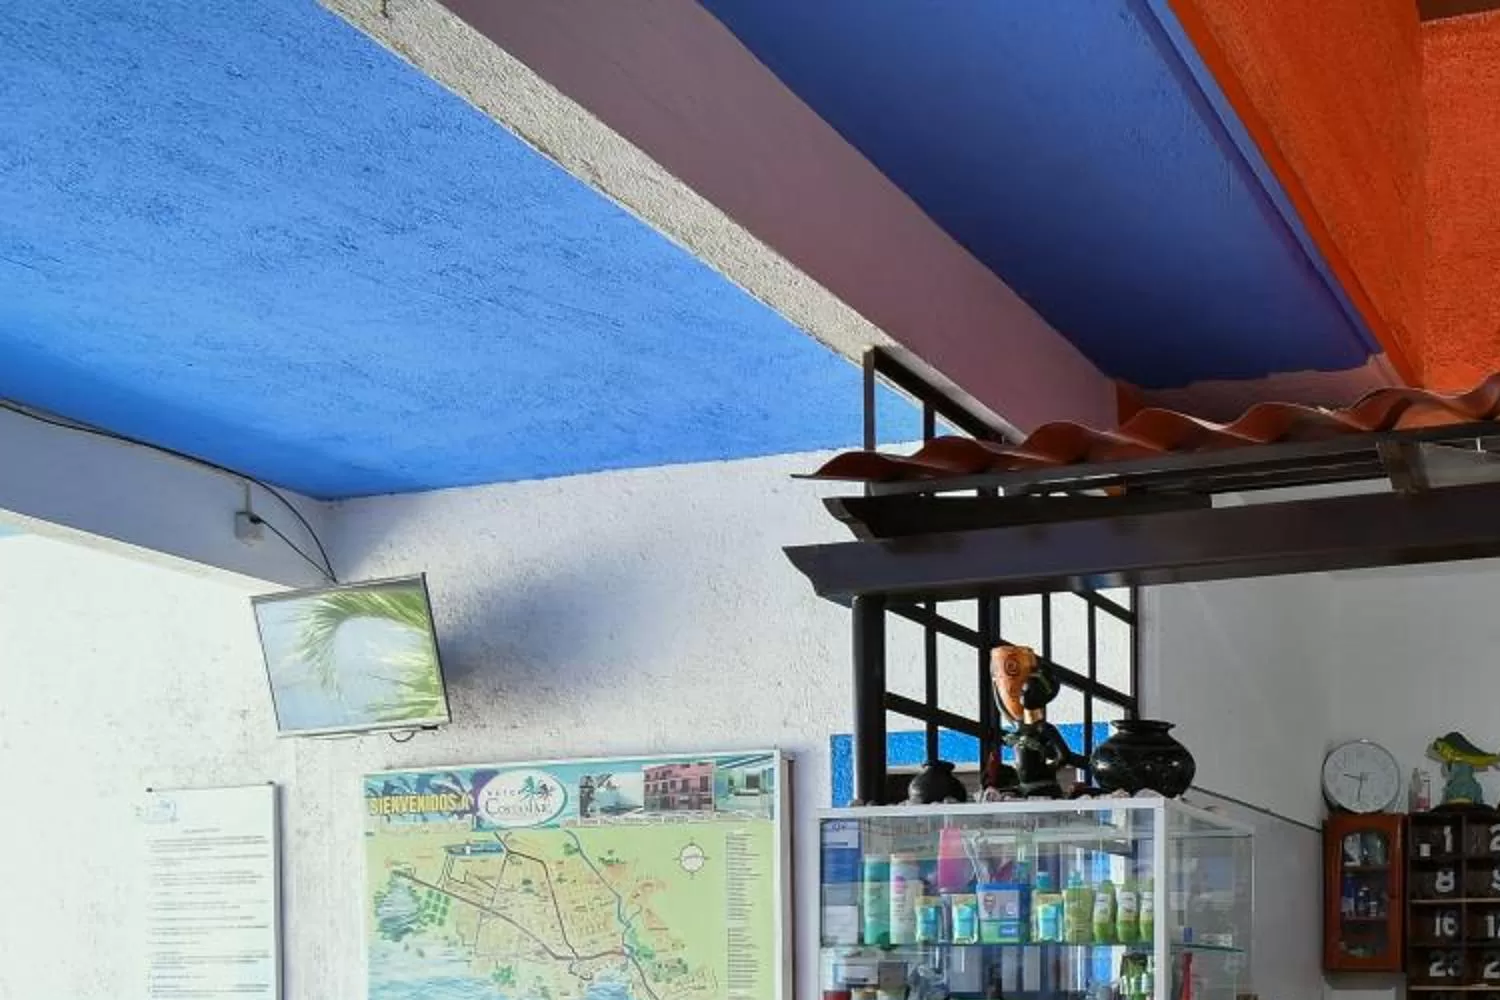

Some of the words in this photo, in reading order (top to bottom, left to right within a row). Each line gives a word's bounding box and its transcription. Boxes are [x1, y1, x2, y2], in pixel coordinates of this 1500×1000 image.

[370, 793, 458, 815] BIENVENIDOS
[1443, 825, 1453, 853] 1
[1435, 864, 1455, 893] 8
[1435, 910, 1458, 938] 16
